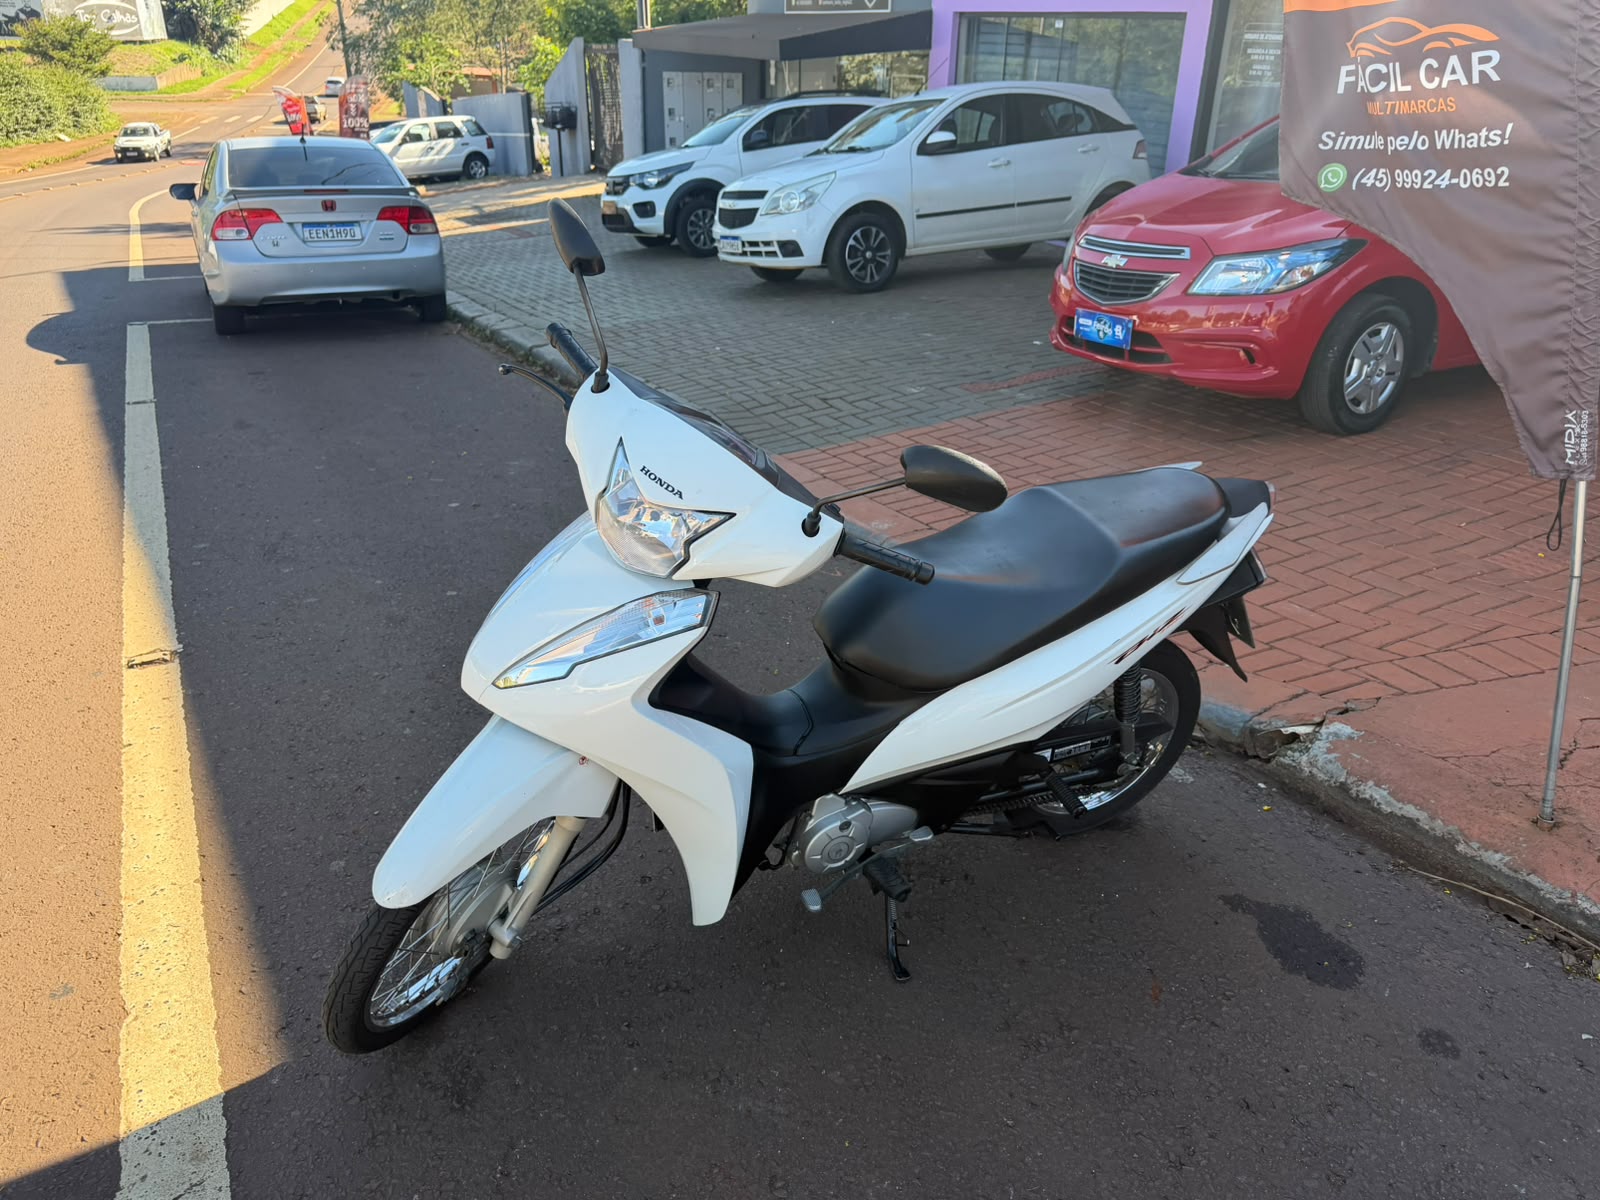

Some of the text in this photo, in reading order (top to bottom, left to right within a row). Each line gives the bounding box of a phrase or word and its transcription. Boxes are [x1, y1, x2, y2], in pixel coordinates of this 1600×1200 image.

[1419, 49, 1501, 88] CAR
[1367, 96, 1457, 116] MULTIMARCAS
[1318, 123, 1514, 155] Simule pelo Whats!
[1352, 166, 1510, 192] (45) 99924-0692
[640, 465, 684, 500] HONDA
